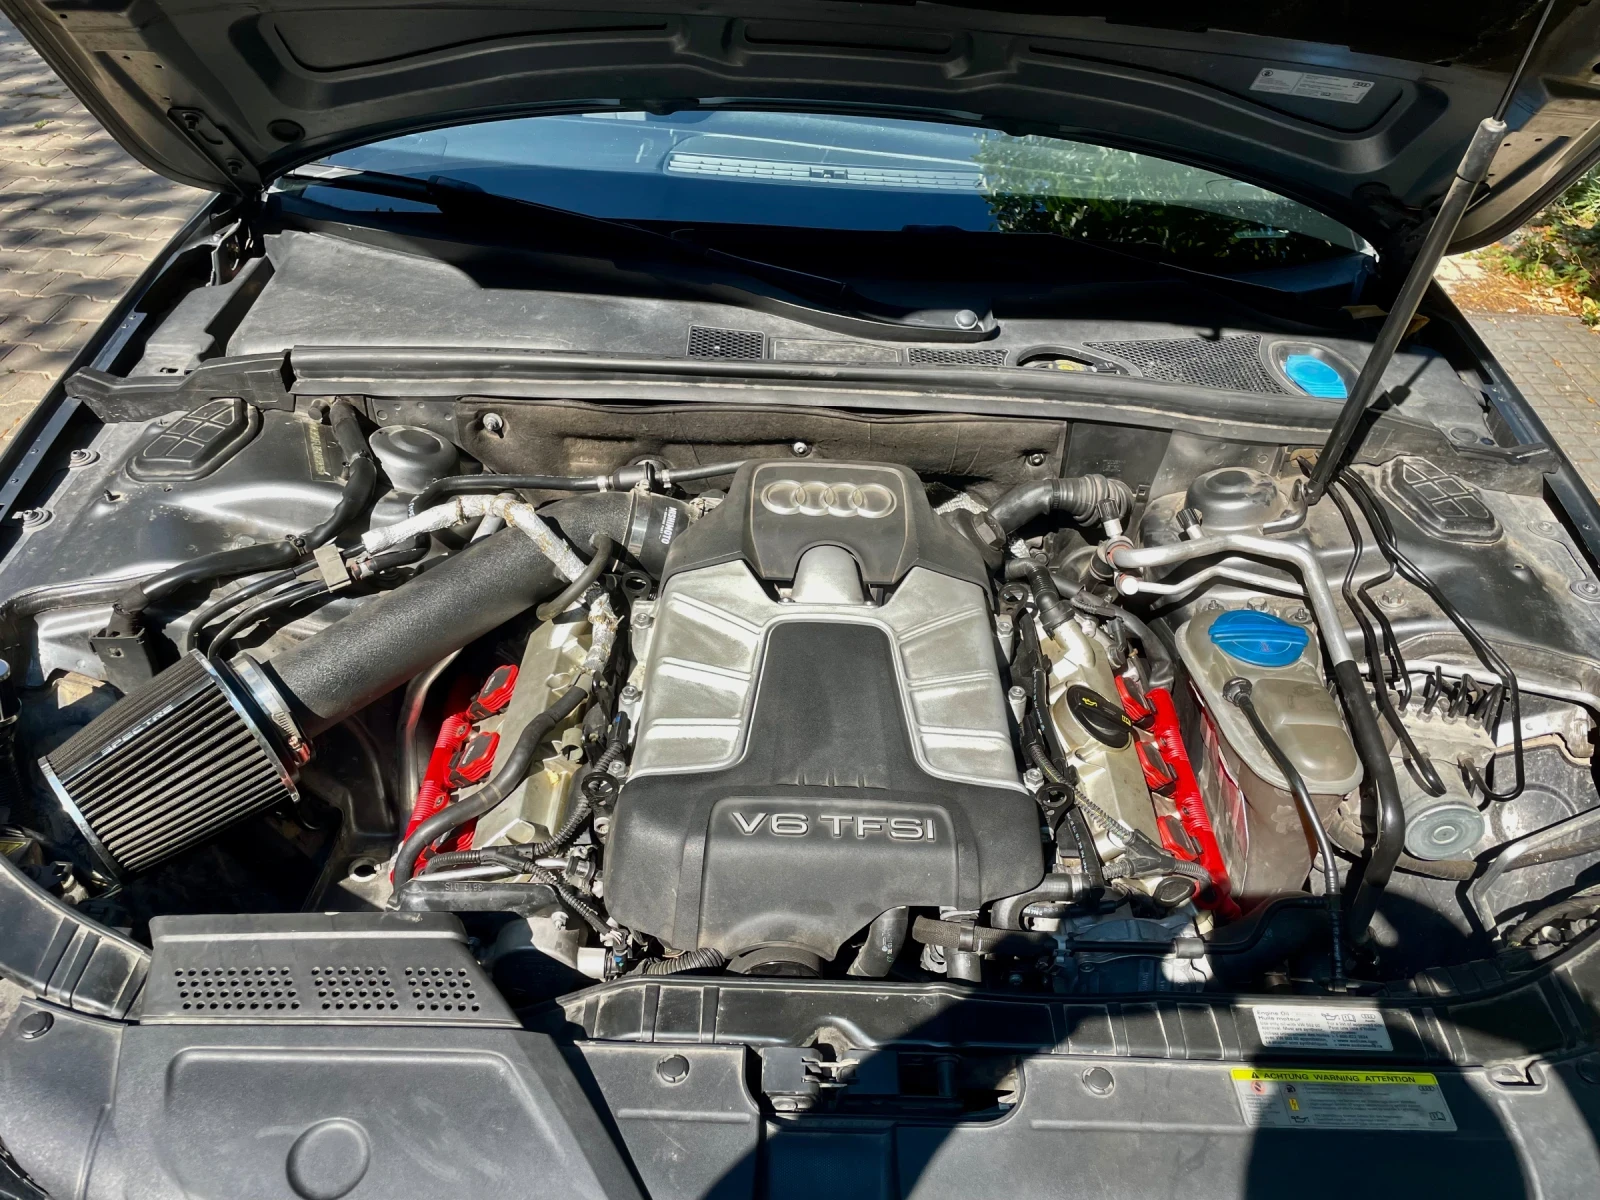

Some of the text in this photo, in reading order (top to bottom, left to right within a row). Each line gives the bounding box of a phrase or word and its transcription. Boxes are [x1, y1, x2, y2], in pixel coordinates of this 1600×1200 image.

[660, 506, 678, 545] MISHIMOTO
[100, 704, 174, 757] SPECTRE
[732, 811, 935, 842] V6 TFSI
[1264, 1072, 1416, 1083] ACHTUNG WARNING ATTENTION
